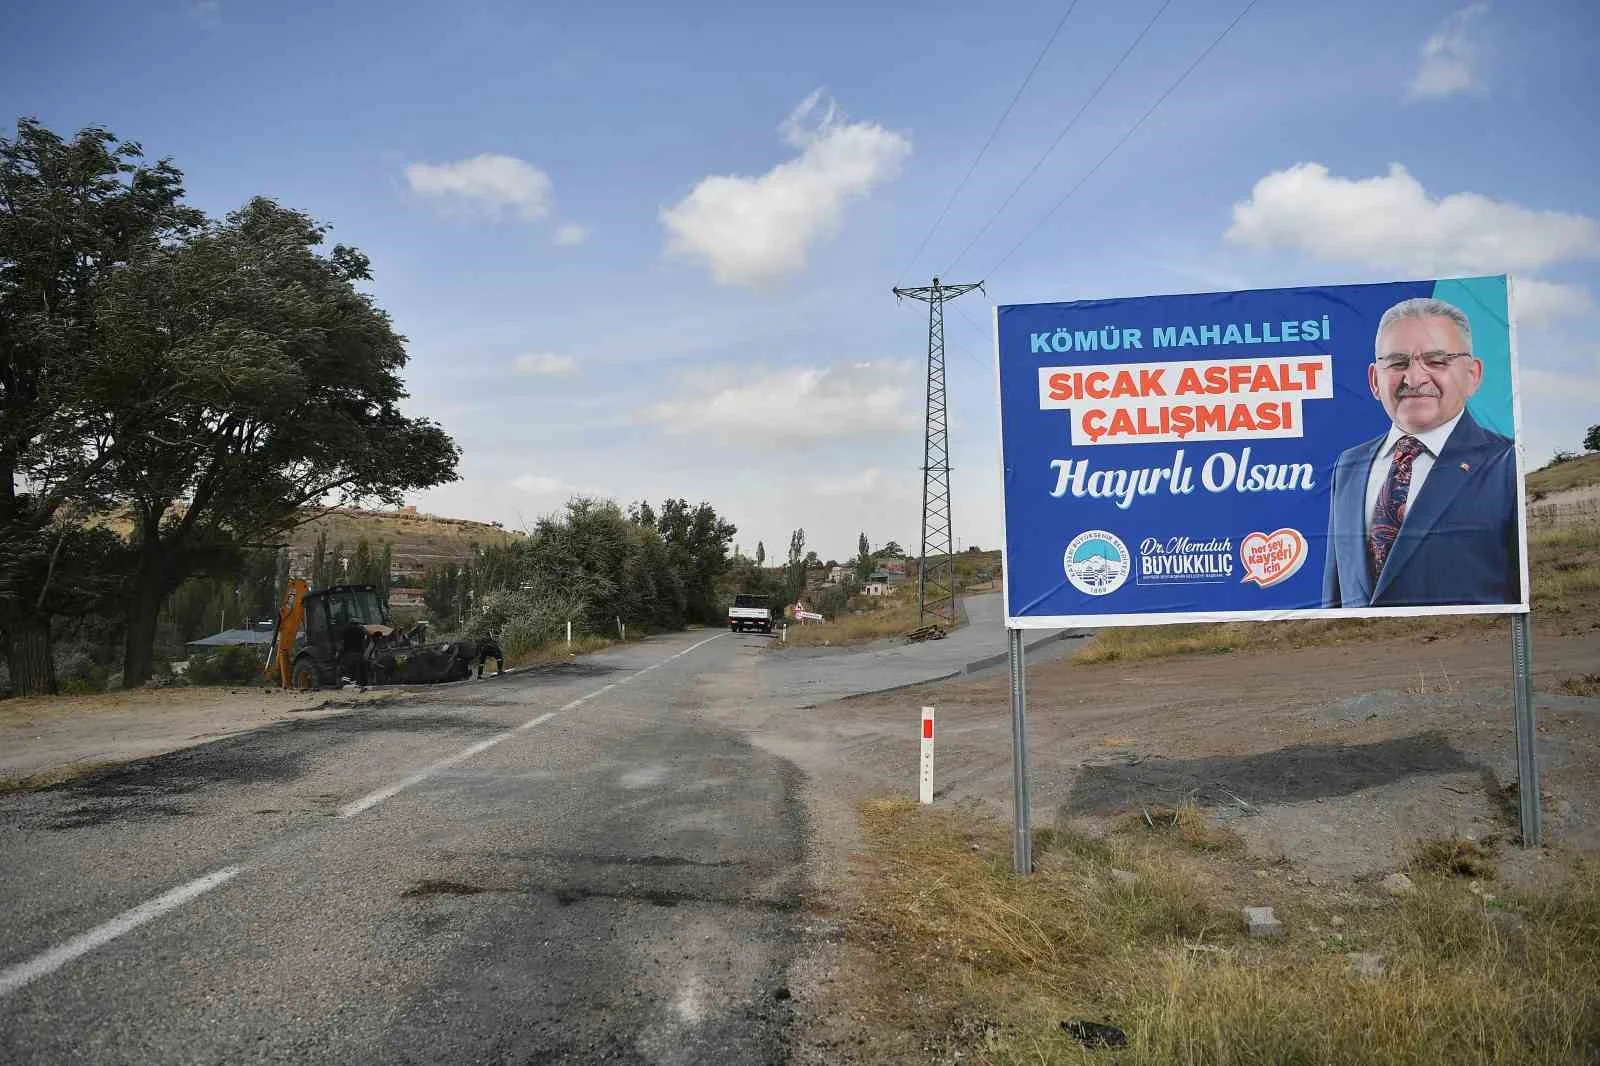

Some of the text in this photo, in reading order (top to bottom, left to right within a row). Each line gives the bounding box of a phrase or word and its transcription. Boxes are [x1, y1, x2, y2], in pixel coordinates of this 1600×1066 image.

[1030, 315, 1331, 353] KÖMÜR MAHALLESİ
[1049, 362, 1323, 401] SICAK ASFALT
[1081, 402, 1292, 443] ÇALIŞMASI
[1049, 447, 1315, 509] Hayırlı Olsun
[1140, 536, 1233, 556] Dr. Memduh
